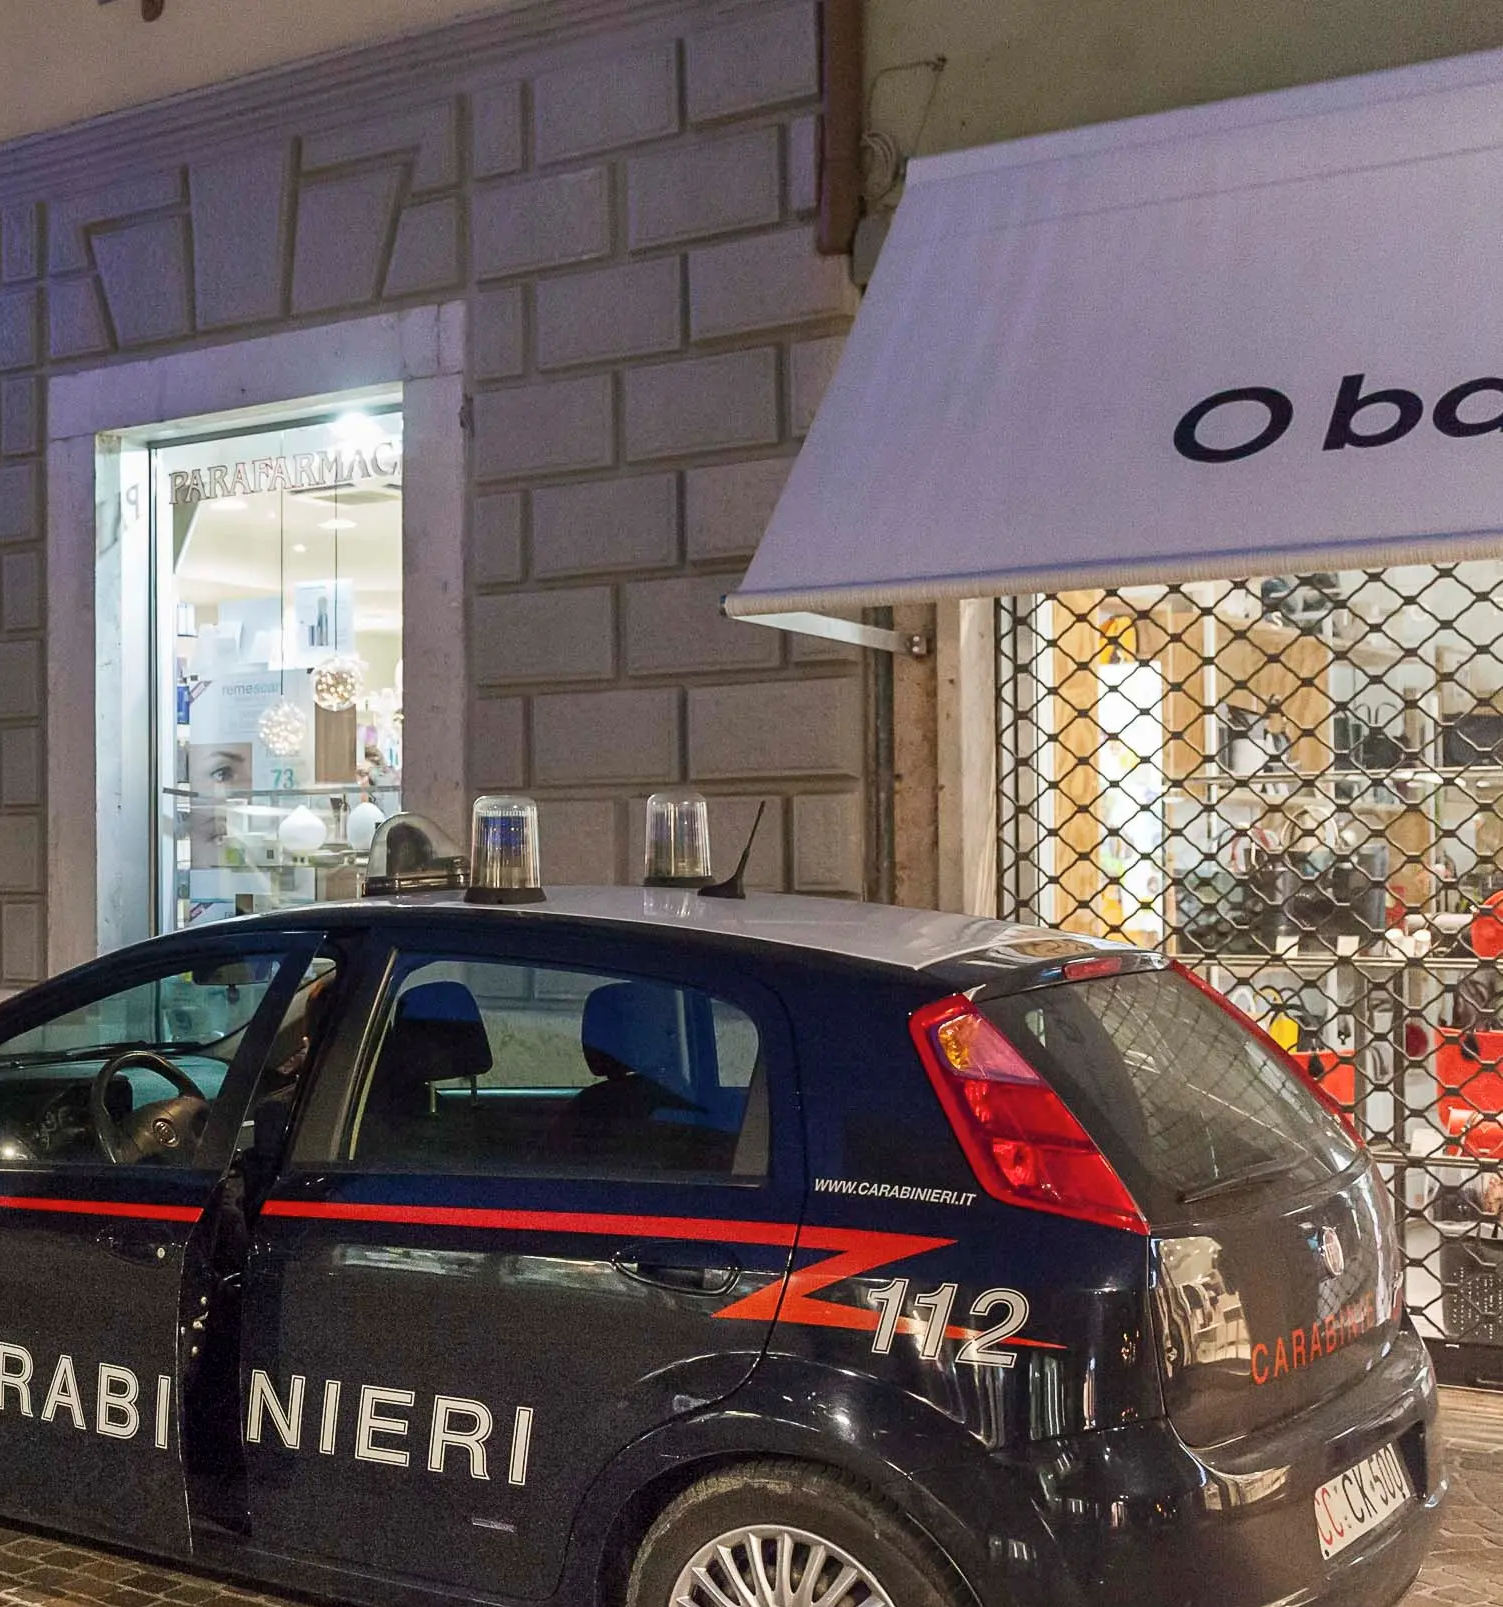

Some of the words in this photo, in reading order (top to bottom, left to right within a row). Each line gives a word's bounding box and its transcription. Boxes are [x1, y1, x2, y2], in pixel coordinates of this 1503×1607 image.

[1172, 386, 1294, 464] O
[168, 441, 402, 505] PARAFARMAC
[814, 1178, 977, 1207] WWW.CARABINIERI.IT
[866, 1278, 1030, 1369] 112
